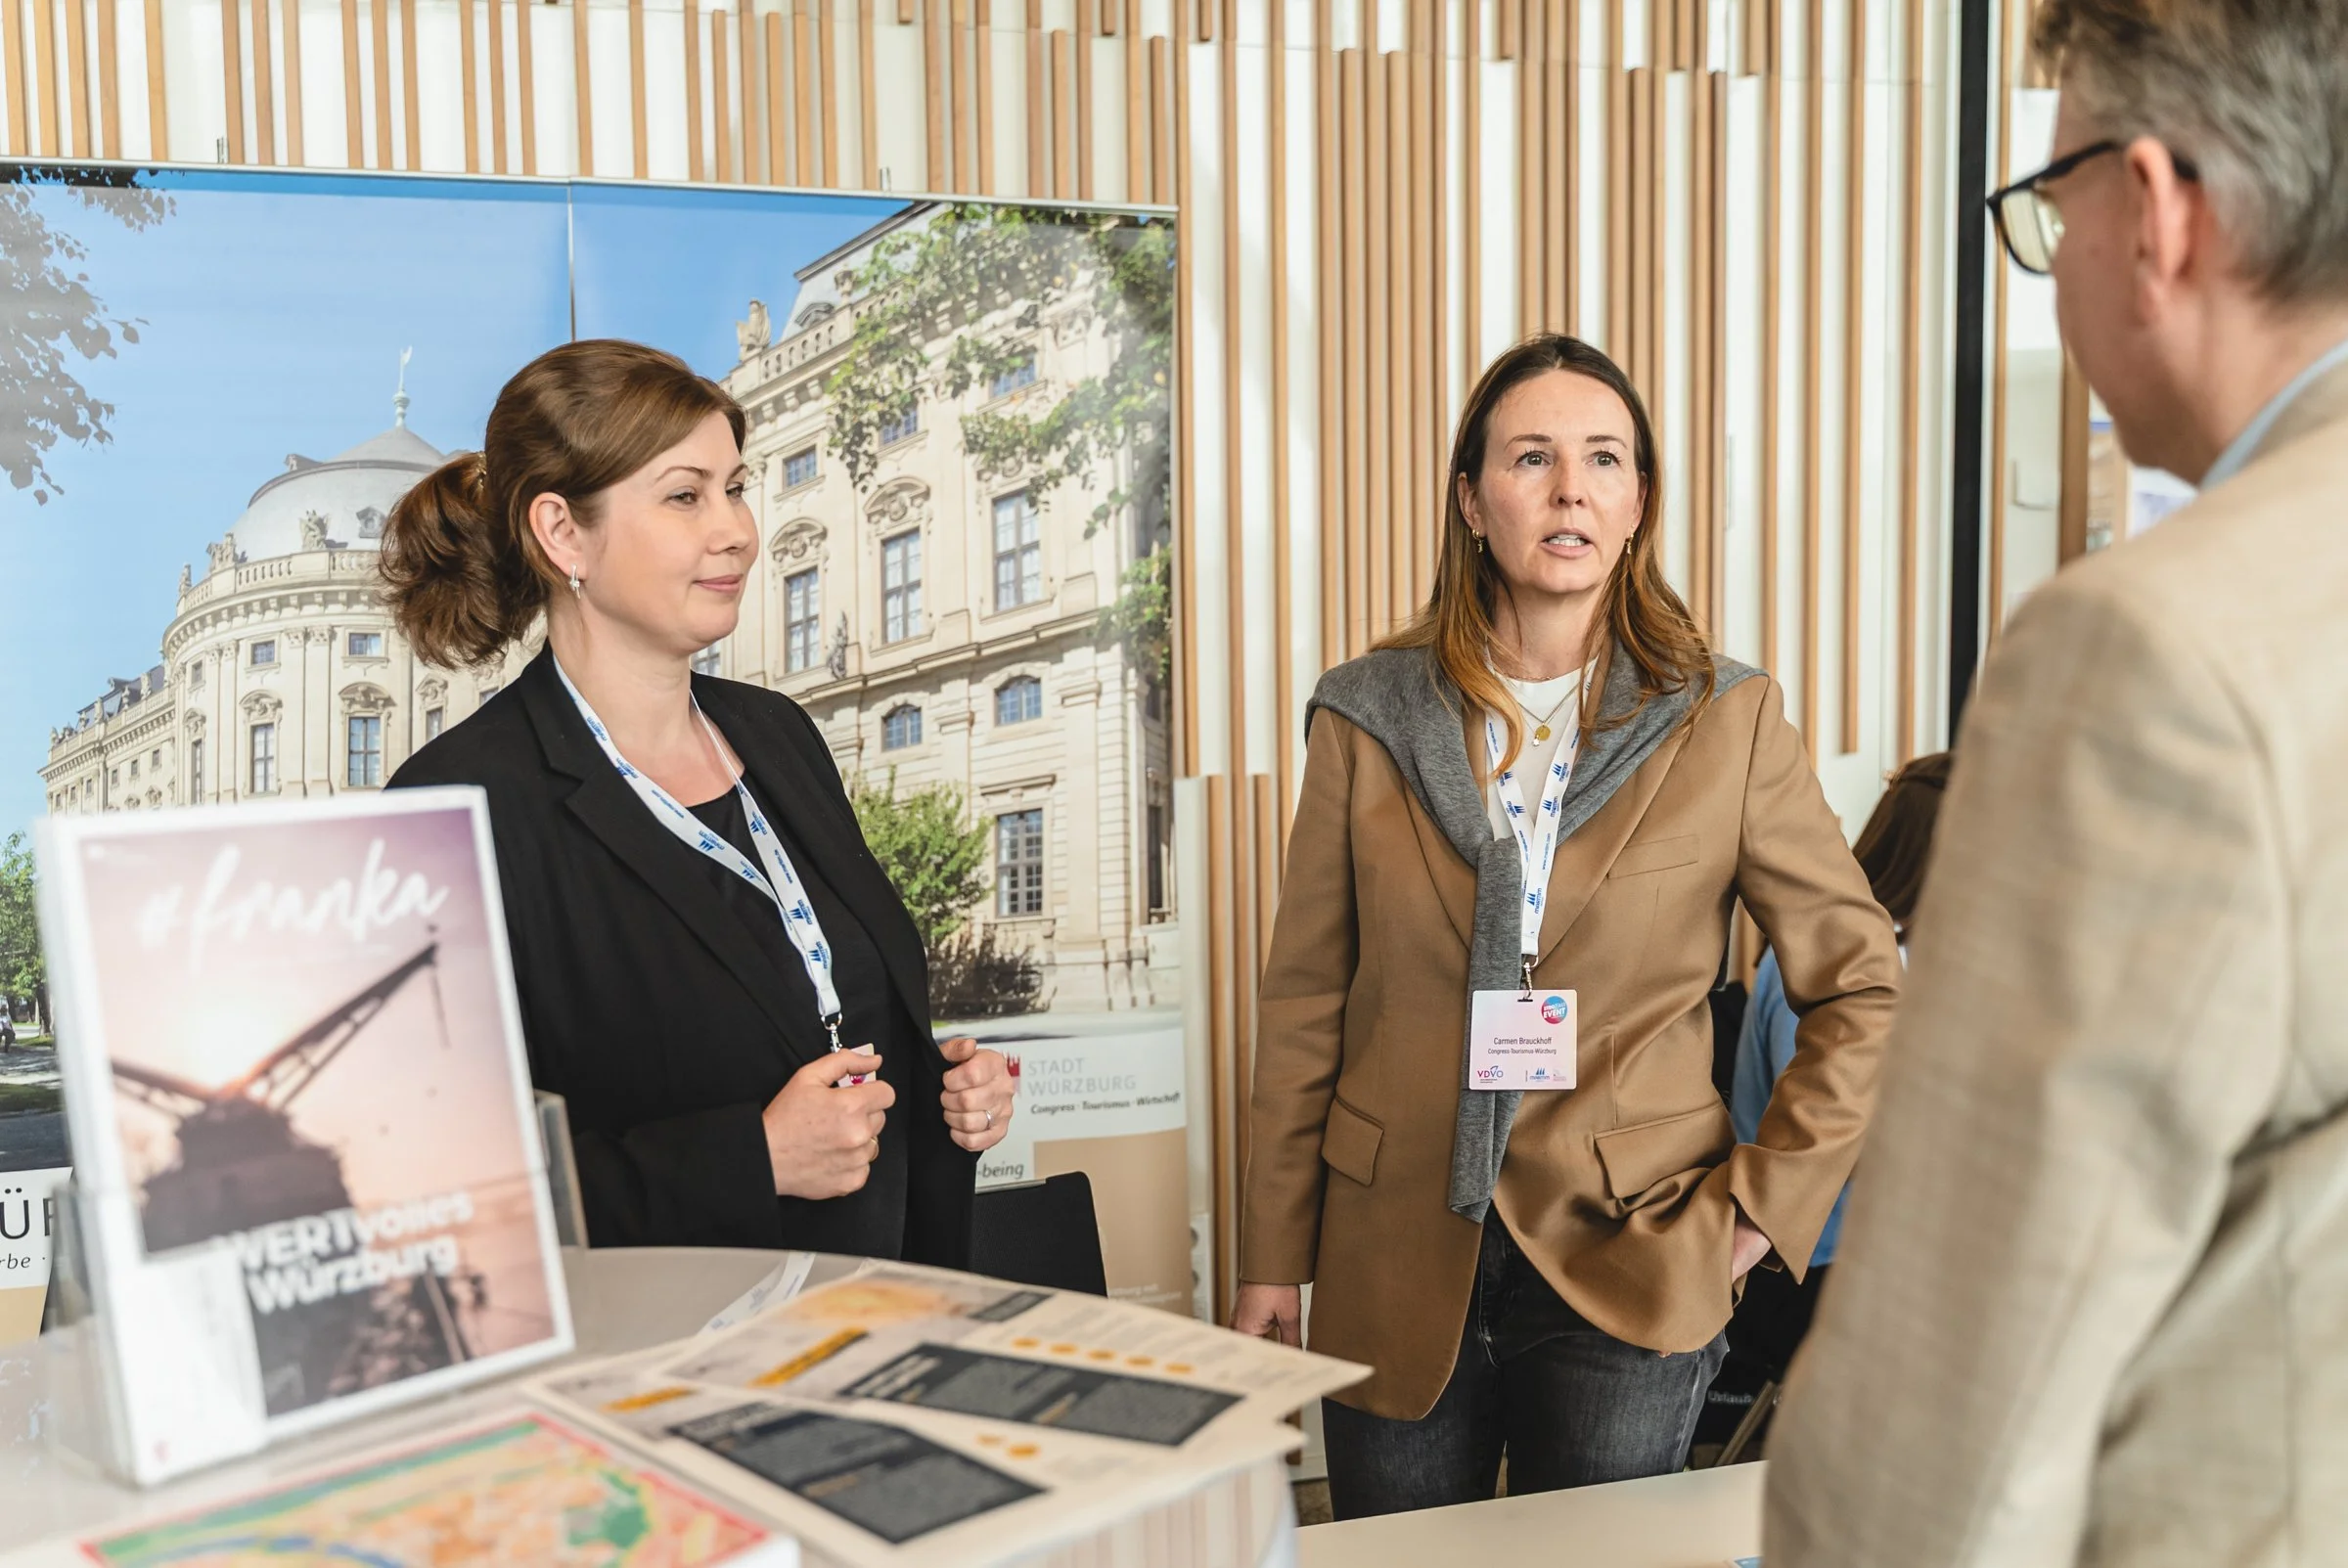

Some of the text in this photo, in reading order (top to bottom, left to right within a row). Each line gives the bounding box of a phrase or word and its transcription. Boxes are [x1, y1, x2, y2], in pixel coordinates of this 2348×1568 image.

[1493, 1037, 1552, 1045] Carmen Brauckhoff
[1028, 1057, 1085, 1076] STADT
[1028, 1075, 1136, 1097] WÜRZBURG
[1030, 1103, 1075, 1115] Congress
[1082, 1100, 1130, 1111] Tourismus
[244, 1233, 458, 1316] Würzburg
